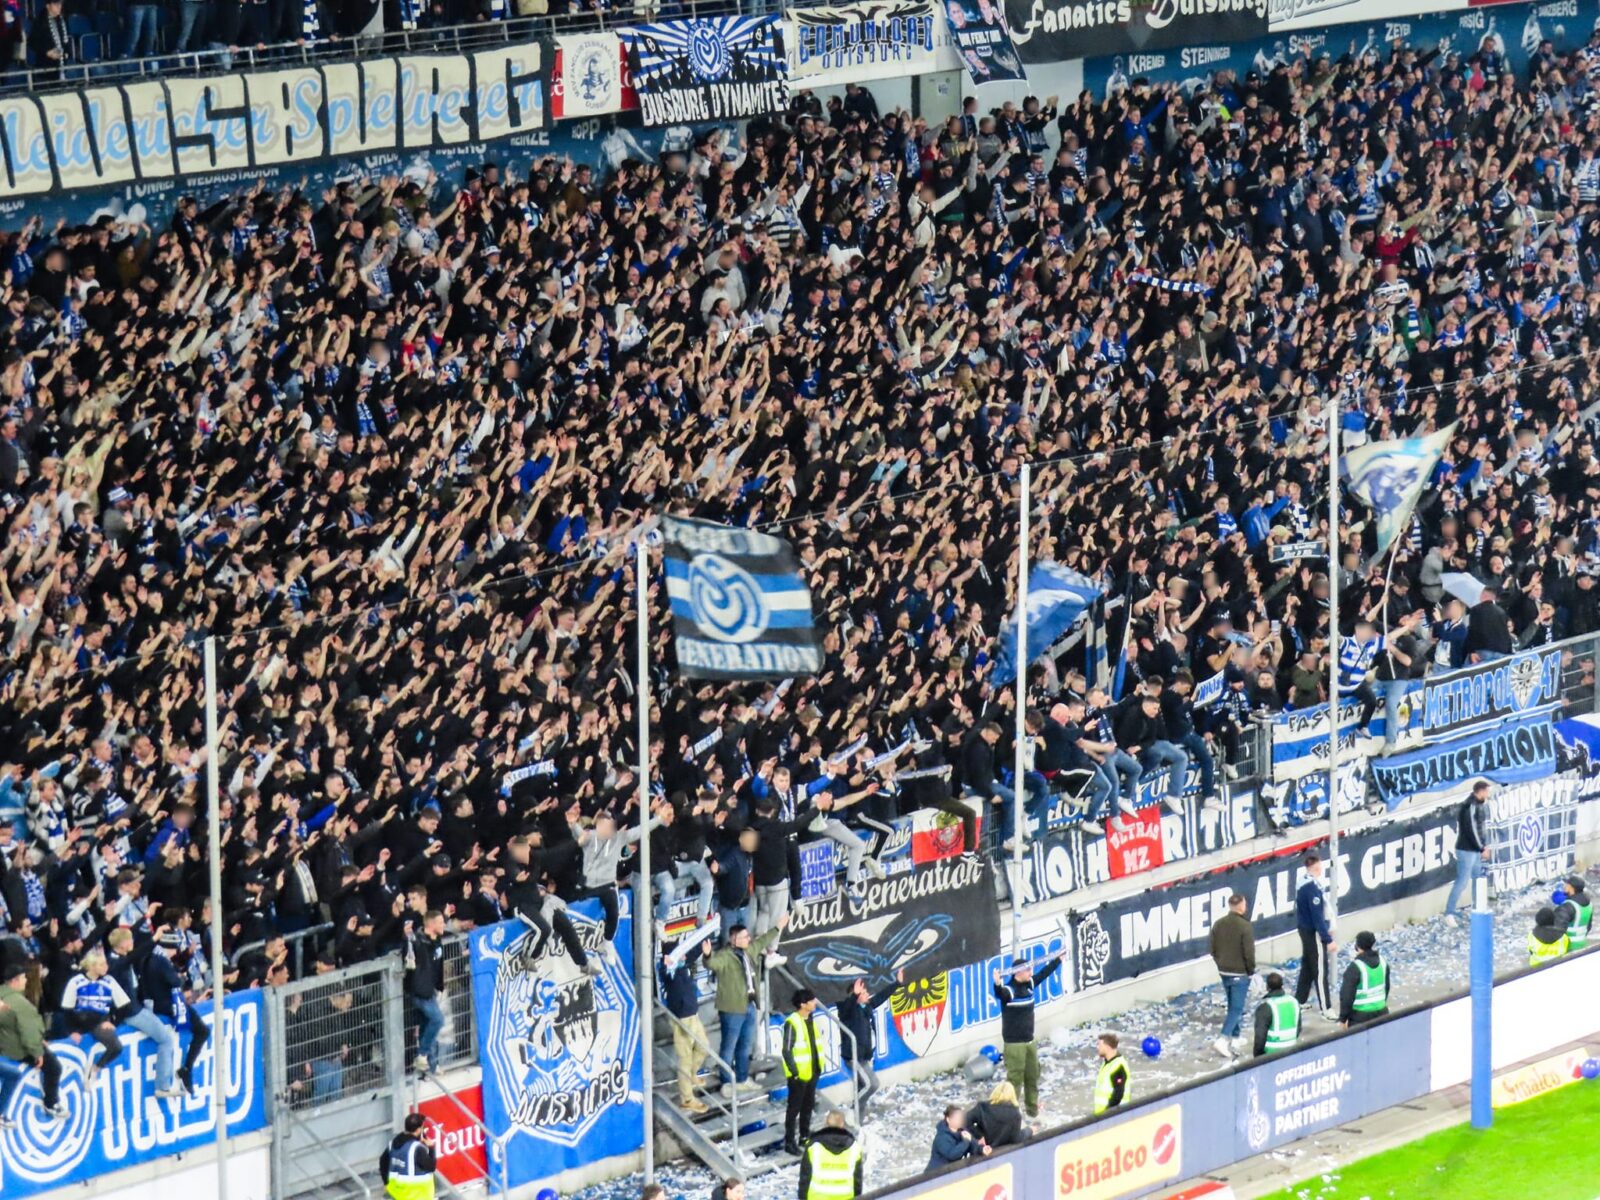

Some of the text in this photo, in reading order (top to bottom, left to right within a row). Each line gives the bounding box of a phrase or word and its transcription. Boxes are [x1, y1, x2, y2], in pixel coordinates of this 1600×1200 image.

[1010, 0, 1131, 46] Fanatics
[822, 43, 912, 70] DUISBURG
[1128, 54, 1165, 75] KREMER
[639, 79, 793, 127] DUISBURG DYNAMITES
[1424, 665, 1512, 731] METROPOL
[1540, 650, 1562, 699] 47
[1376, 721, 1553, 795] WEDAUSTADION
[1489, 779, 1575, 822] RUHRPOTT
[1005, 790, 1257, 903] KOHRTE
[1110, 821, 1160, 849] ULTRAS
[1361, 822, 1459, 890] GEBEN
[1123, 846, 1150, 875] MZ
[787, 896, 845, 932] roud
[850, 857, 983, 919] Generation
[949, 937, 1064, 1032] DUISRG
[1275, 1054, 1336, 1086] OFFIZIELLER
[1275, 1069, 1351, 1111] EXKLUSIV-
[509, 1059, 630, 1128] DUISBURG
[1275, 1097, 1340, 1136] PARTNER
[422, 1122, 487, 1159] Heut
[1060, 1144, 1148, 1195] Sinalco
